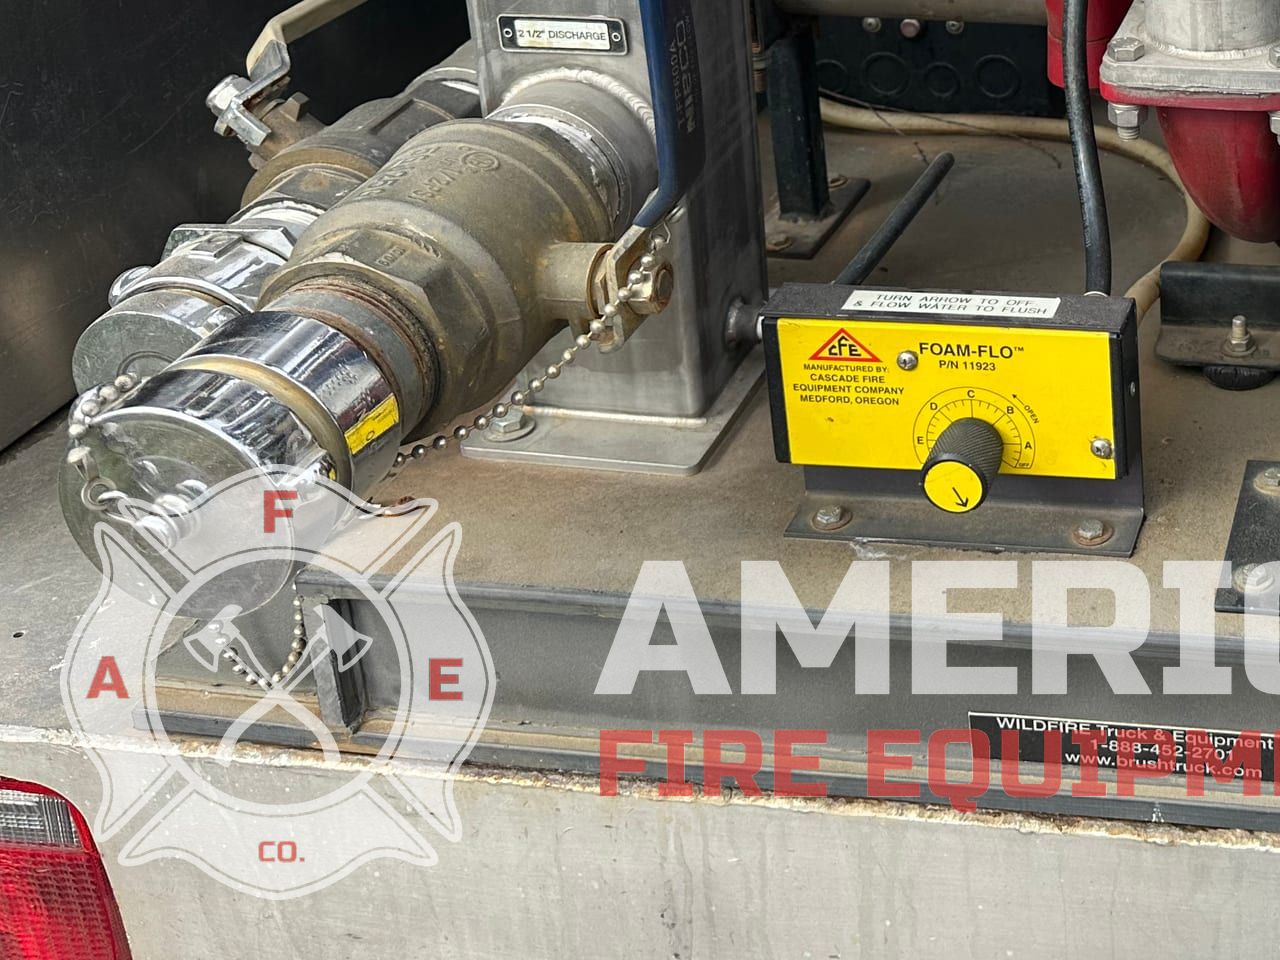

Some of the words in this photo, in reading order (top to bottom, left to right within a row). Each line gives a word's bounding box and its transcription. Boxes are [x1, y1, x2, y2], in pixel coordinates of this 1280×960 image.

[517, 29, 525, 38] 2
[548, 30, 607, 41] DISCHARGE
[875, 293, 914, 304] TURN
[920, 294, 972, 305] ARROW
[980, 296, 999, 306] TO
[1006, 298, 1033, 307] OFF
[852, 299, 864, 308] &
[870, 300, 913, 310] FLOW
[918, 301, 970, 313] WATER
[976, 304, 996, 313] TO
[1000, 305, 1049, 316] FLUSH
[828, 335, 860, 357] CFE
[803, 363, 875, 373] MANUFACTURED
[939, 359, 960, 370] P/N
[963, 361, 996, 372] 11923
[810, 373, 860, 383] CASCADE
[862, 375, 886, 384] FIRE
[793, 384, 853, 394] EQUIPMENT
[854, 385, 905, 395] COMPANY
[967, 389, 976, 399] C
[799, 394, 853, 405] MEDFORD,
[855, 396, 900, 406] OREGON
[930, 402, 939, 412] D
[1006, 406, 1014, 415] B
[1023, 404, 1040, 425] OPEN
[916, 436, 924, 445] E
[1024, 441, 1033, 450] A
[996, 717, 1091, 736] WILDFIRE
[1095, 724, 1149, 740] Truck
[1153, 728, 1168, 741] &
[1173, 730, 1275, 752] Equipment
[1089, 739, 1235, 761] 1-888-452-2701
[1065, 751, 1263, 779] www.brushtruck.com
